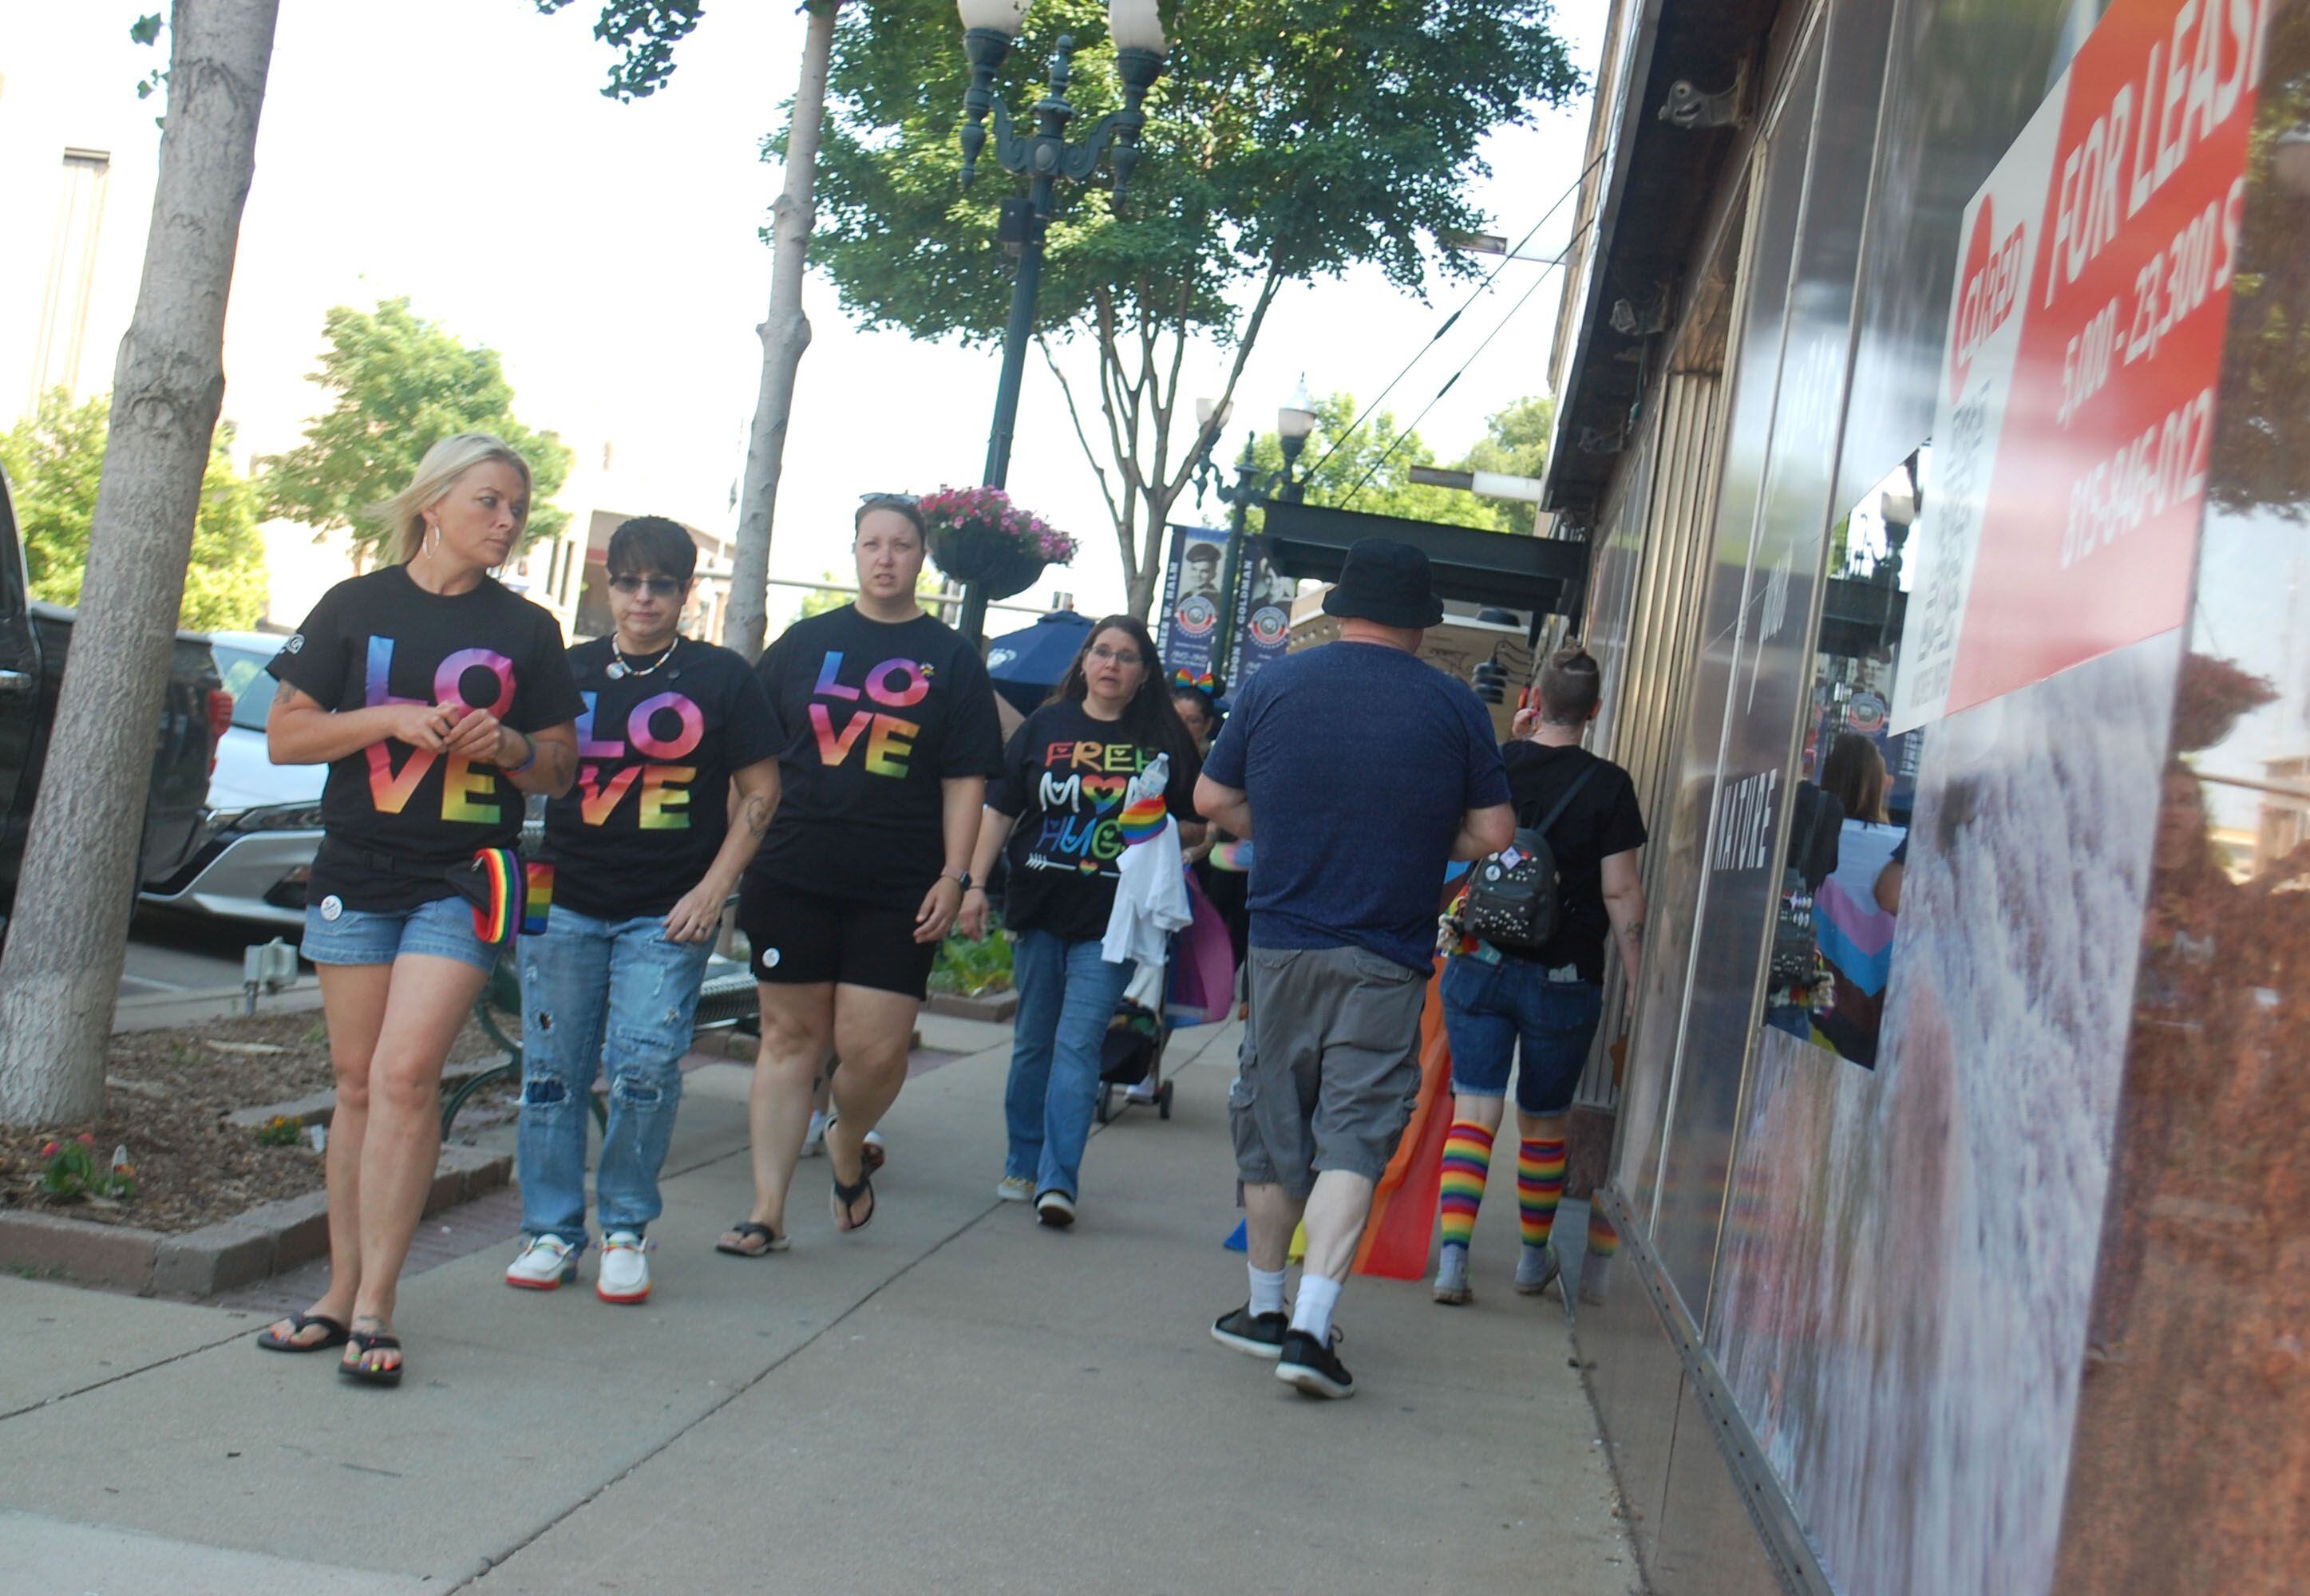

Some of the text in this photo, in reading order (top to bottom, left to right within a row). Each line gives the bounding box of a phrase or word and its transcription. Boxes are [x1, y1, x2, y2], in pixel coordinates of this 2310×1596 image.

[2044, 83, 2132, 310] FOR
[2123, 200, 2219, 368] 23,300
[1236, 560, 1253, 624] GOLDMAN
[1035, 814, 1127, 859] HUG
[1714, 768, 1778, 871] NATURE
